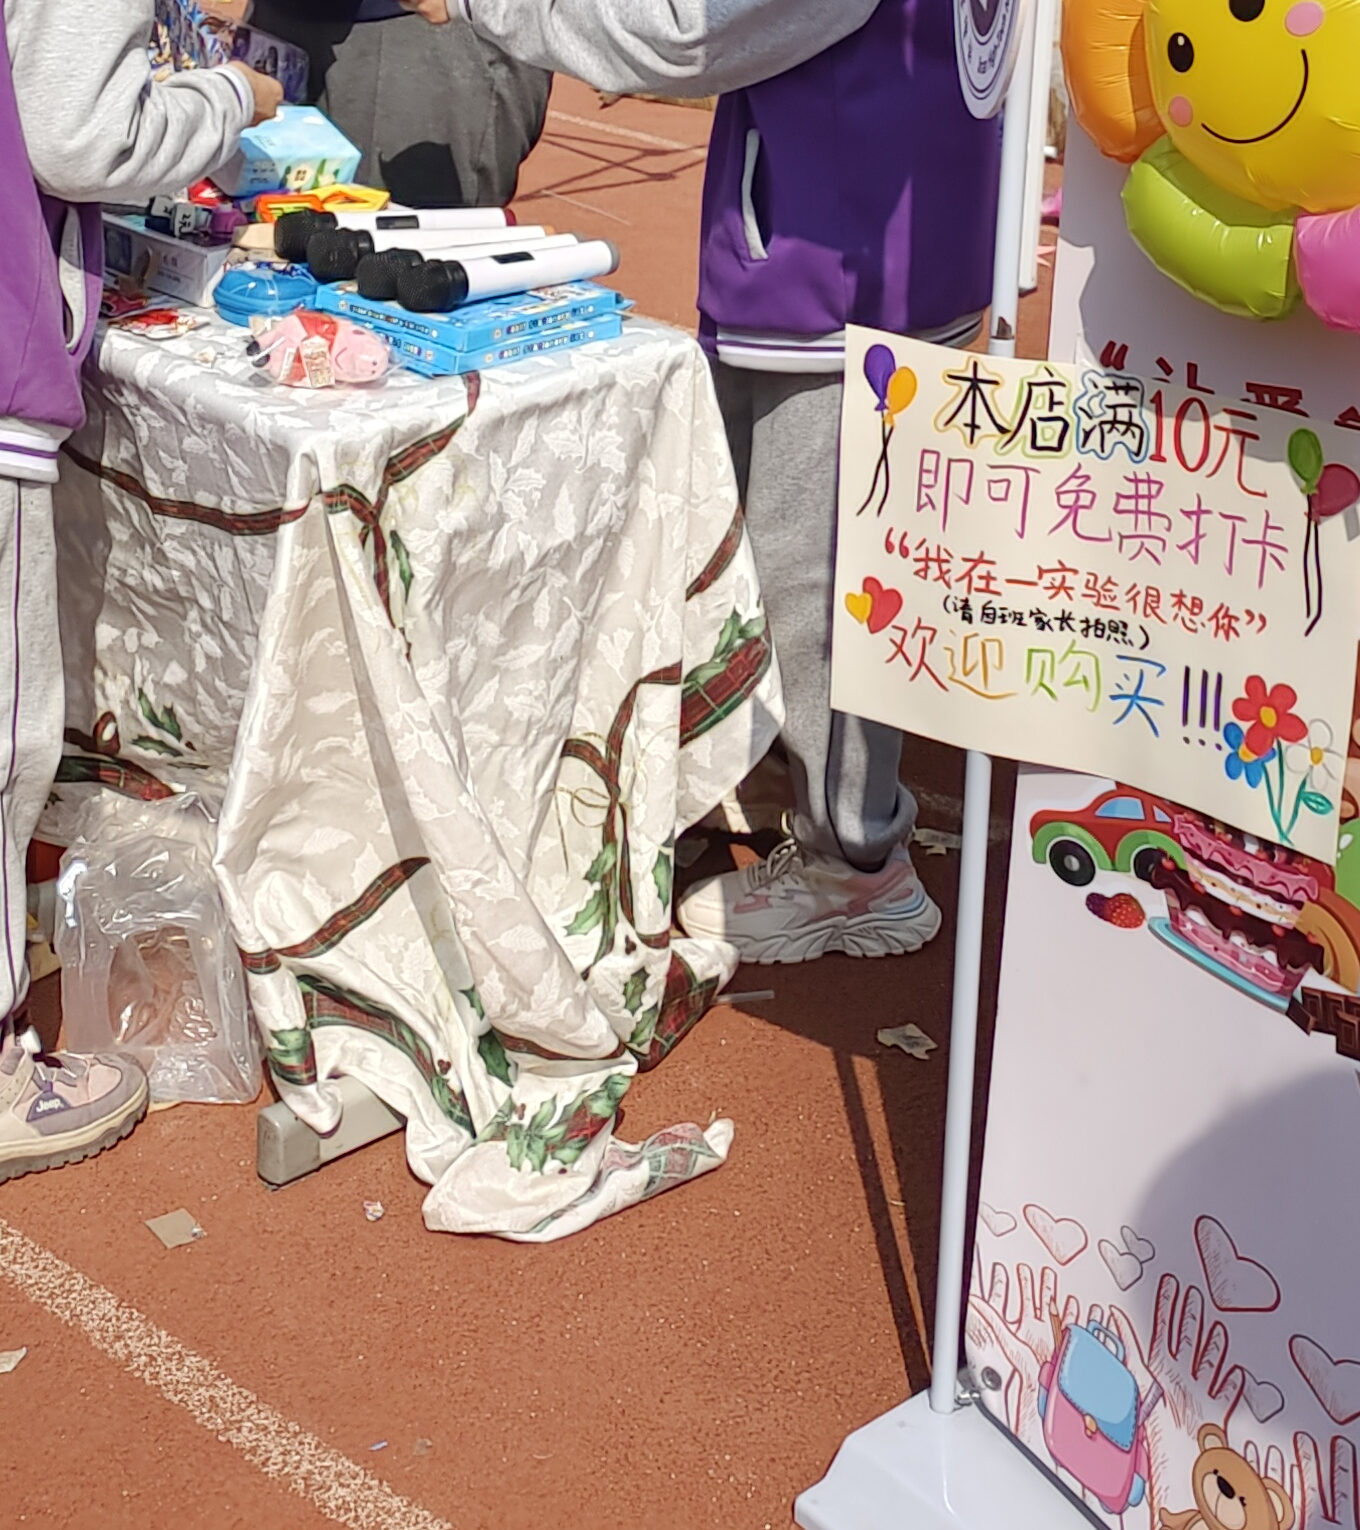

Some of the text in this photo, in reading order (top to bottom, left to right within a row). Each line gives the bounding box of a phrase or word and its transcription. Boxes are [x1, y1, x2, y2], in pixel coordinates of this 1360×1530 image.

[945, 360, 1267, 498] 本店满10元
[916, 449, 1289, 587] 即可免费打卡
